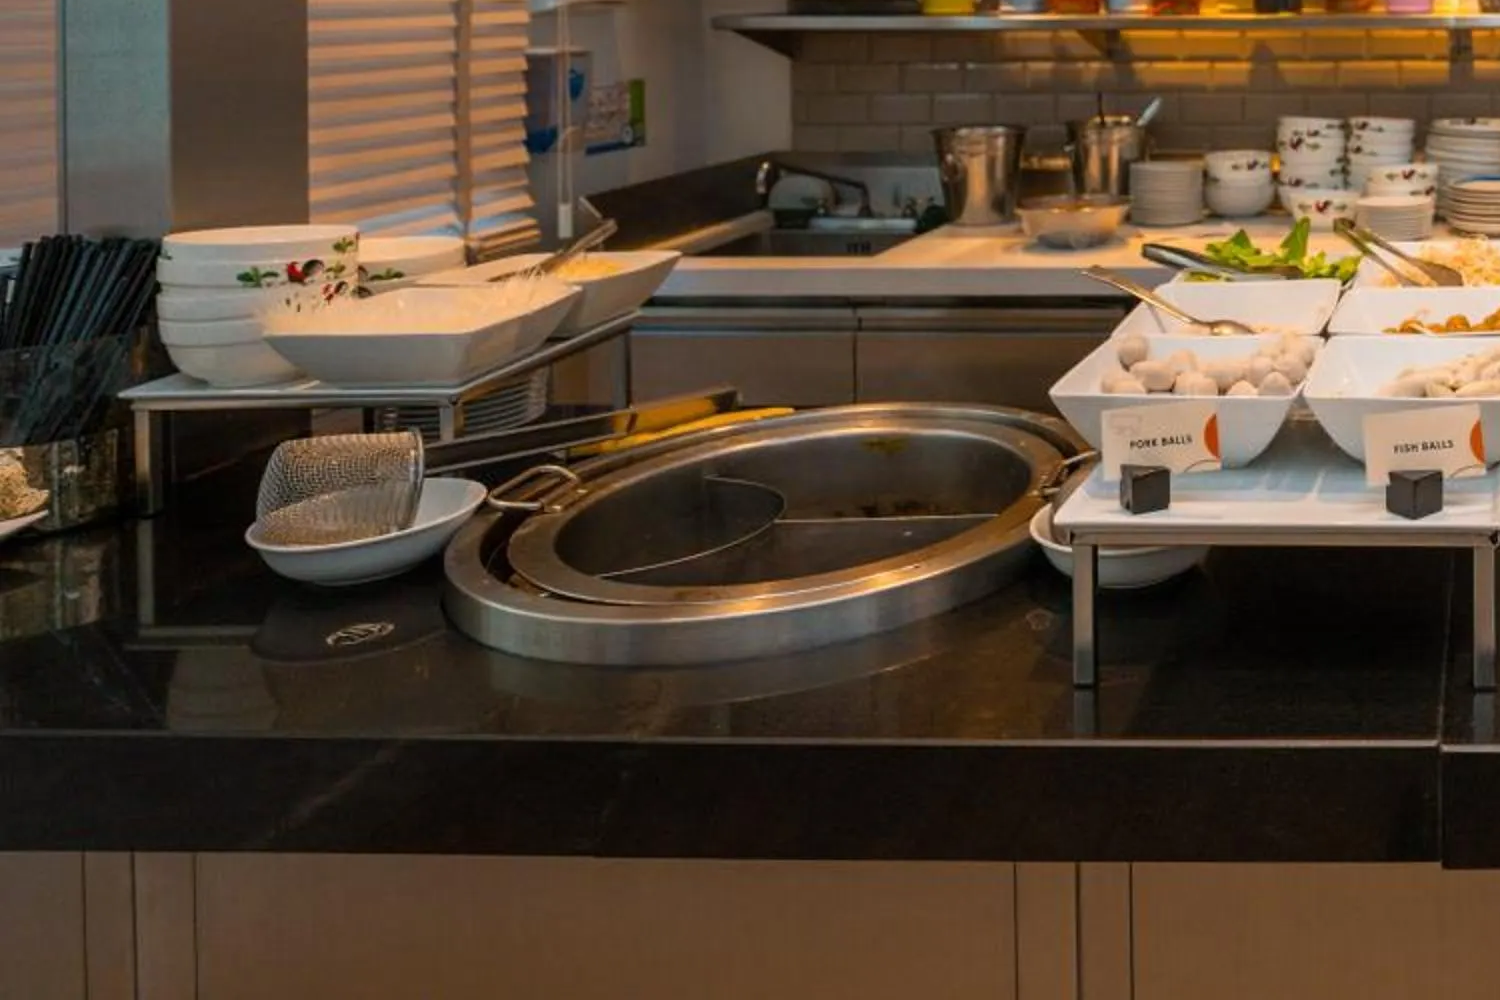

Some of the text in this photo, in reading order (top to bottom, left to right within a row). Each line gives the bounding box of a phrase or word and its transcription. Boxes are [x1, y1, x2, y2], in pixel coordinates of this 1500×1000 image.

[1129, 434, 1193, 450] PORK BALLS
[1393, 439, 1454, 454] FISH BALLS
